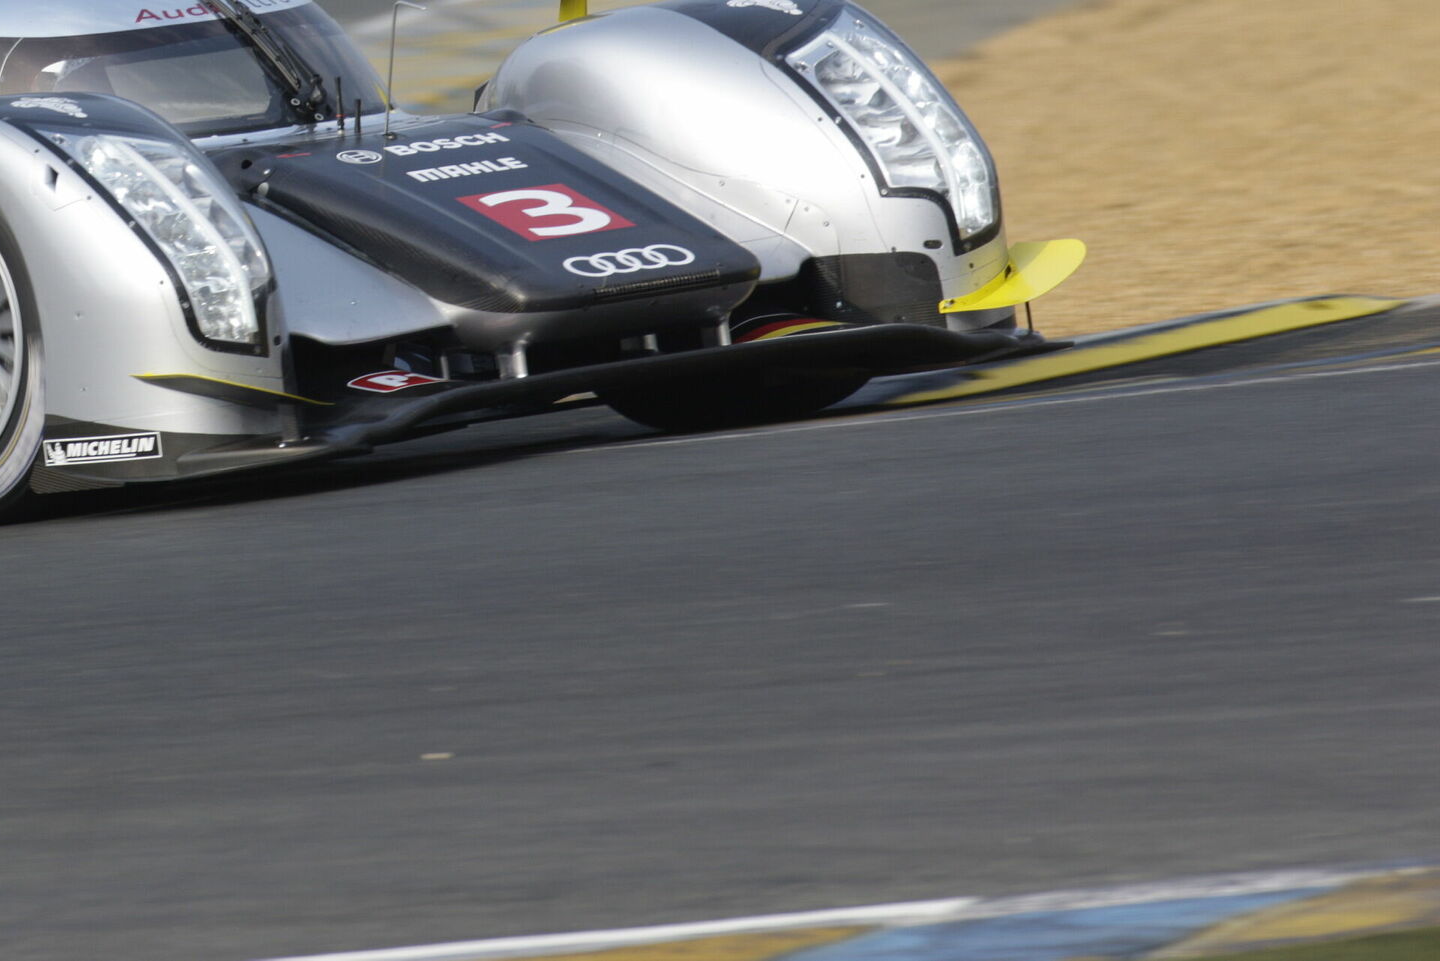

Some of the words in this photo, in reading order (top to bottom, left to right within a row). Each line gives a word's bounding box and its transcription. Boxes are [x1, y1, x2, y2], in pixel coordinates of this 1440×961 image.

[384, 132, 510, 156] BOSCH
[406, 157, 528, 182] MAHLE
[478, 189, 611, 236] 3
[66, 437, 156, 458] MICHELIN
